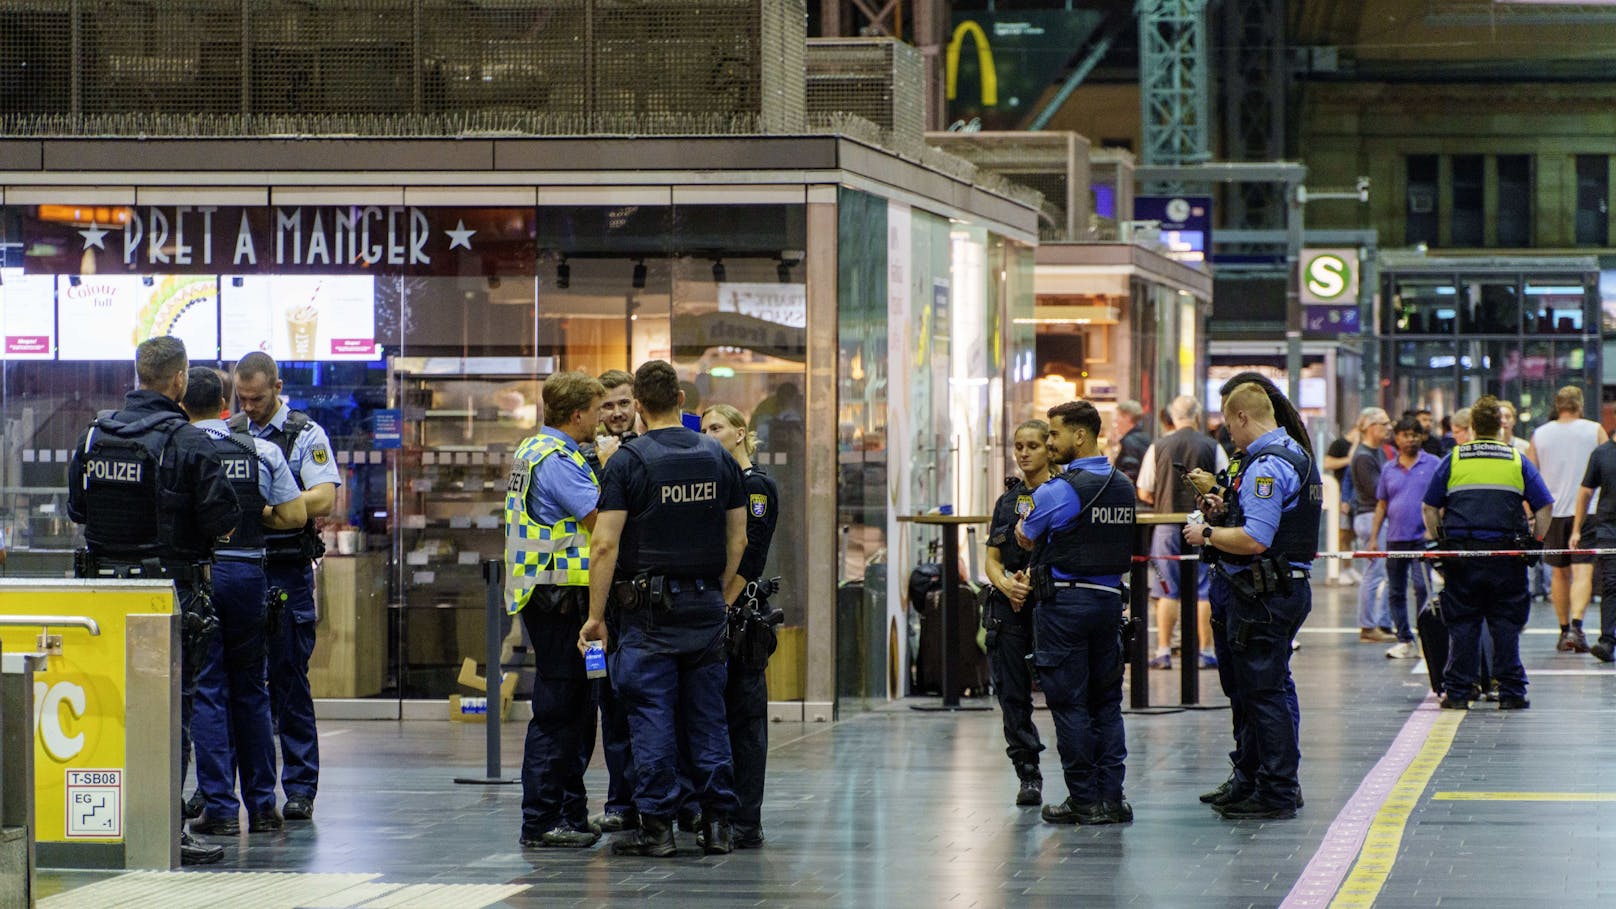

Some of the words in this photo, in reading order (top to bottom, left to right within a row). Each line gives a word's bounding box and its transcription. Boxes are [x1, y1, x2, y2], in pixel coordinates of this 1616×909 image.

[123, 206, 218, 265] PRET
[232, 207, 257, 265] A
[276, 206, 431, 265] MANGER
[1309, 256, 1344, 297] S
[86, 459, 141, 482] POLIZEI
[221, 459, 250, 478] ZEI
[661, 481, 717, 504] POLIZEI
[1091, 506, 1134, 524] POLIZEI
[72, 773, 116, 785] T-SB08
[75, 794, 92, 804] EG
[102, 818, 112, 828] -1
